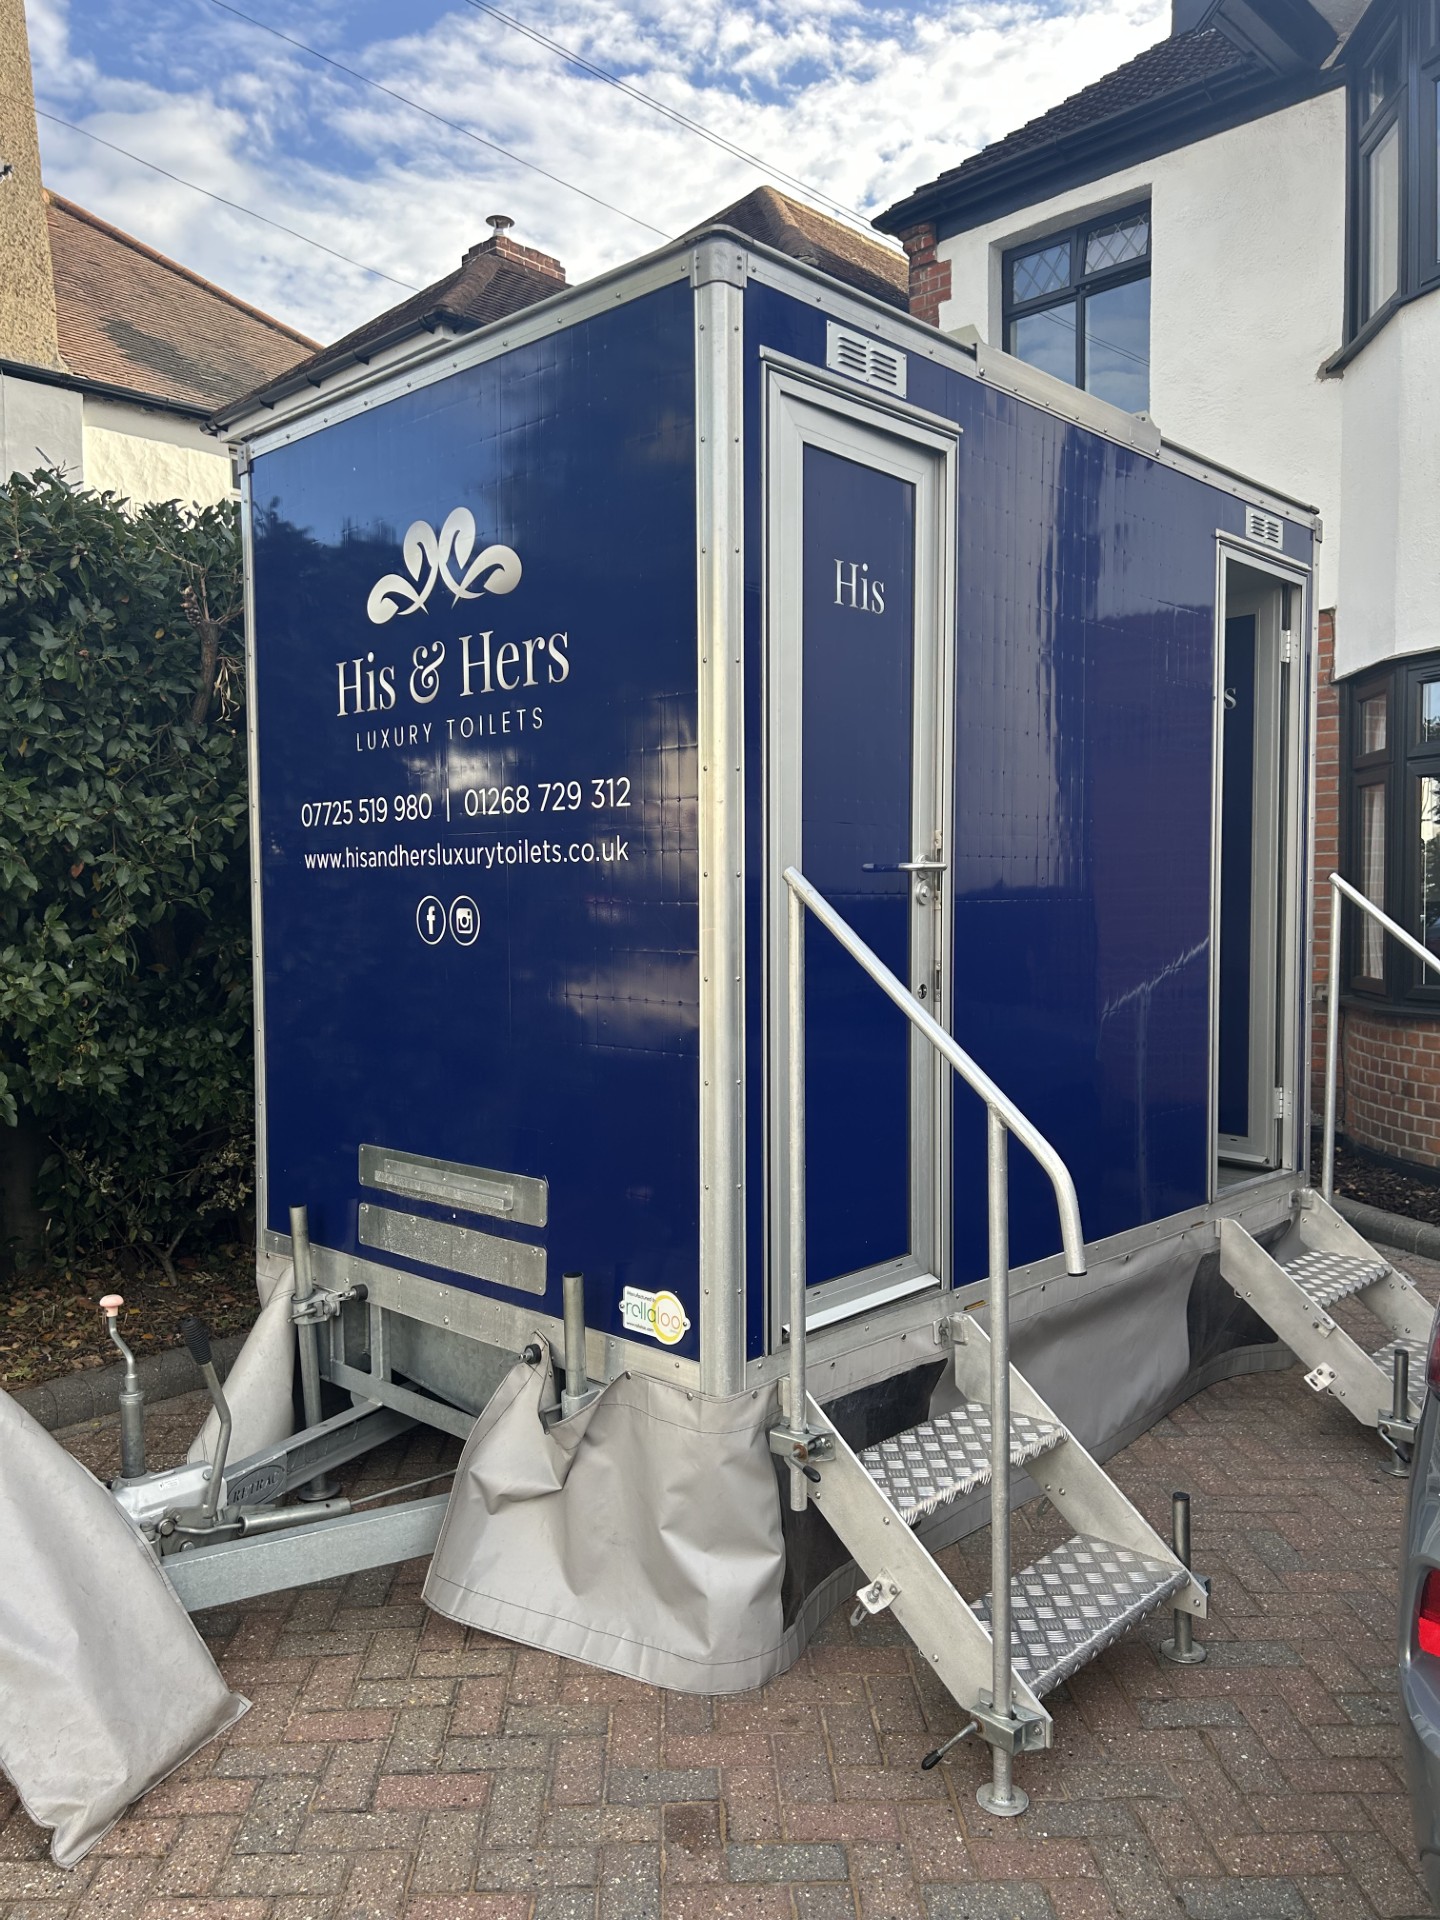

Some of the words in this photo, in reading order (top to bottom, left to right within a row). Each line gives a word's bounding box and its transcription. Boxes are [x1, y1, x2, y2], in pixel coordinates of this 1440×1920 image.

[834, 558, 884, 615] His
[336, 652, 396, 717] His
[409, 640, 446, 704] &
[459, 630, 570, 697] Hers
[356, 722, 432, 752] LUXURY
[447, 707, 544, 740] TOILETS
[301, 800, 353, 827] 07725
[358, 797, 387, 824] 519
[394, 794, 432, 822] 980
[464, 786, 530, 816] 01268
[537, 781, 582, 812] 729
[591, 776, 631, 809] 312
[304, 835, 629, 869] www.hisandhersluxurytoilets.co.uk
